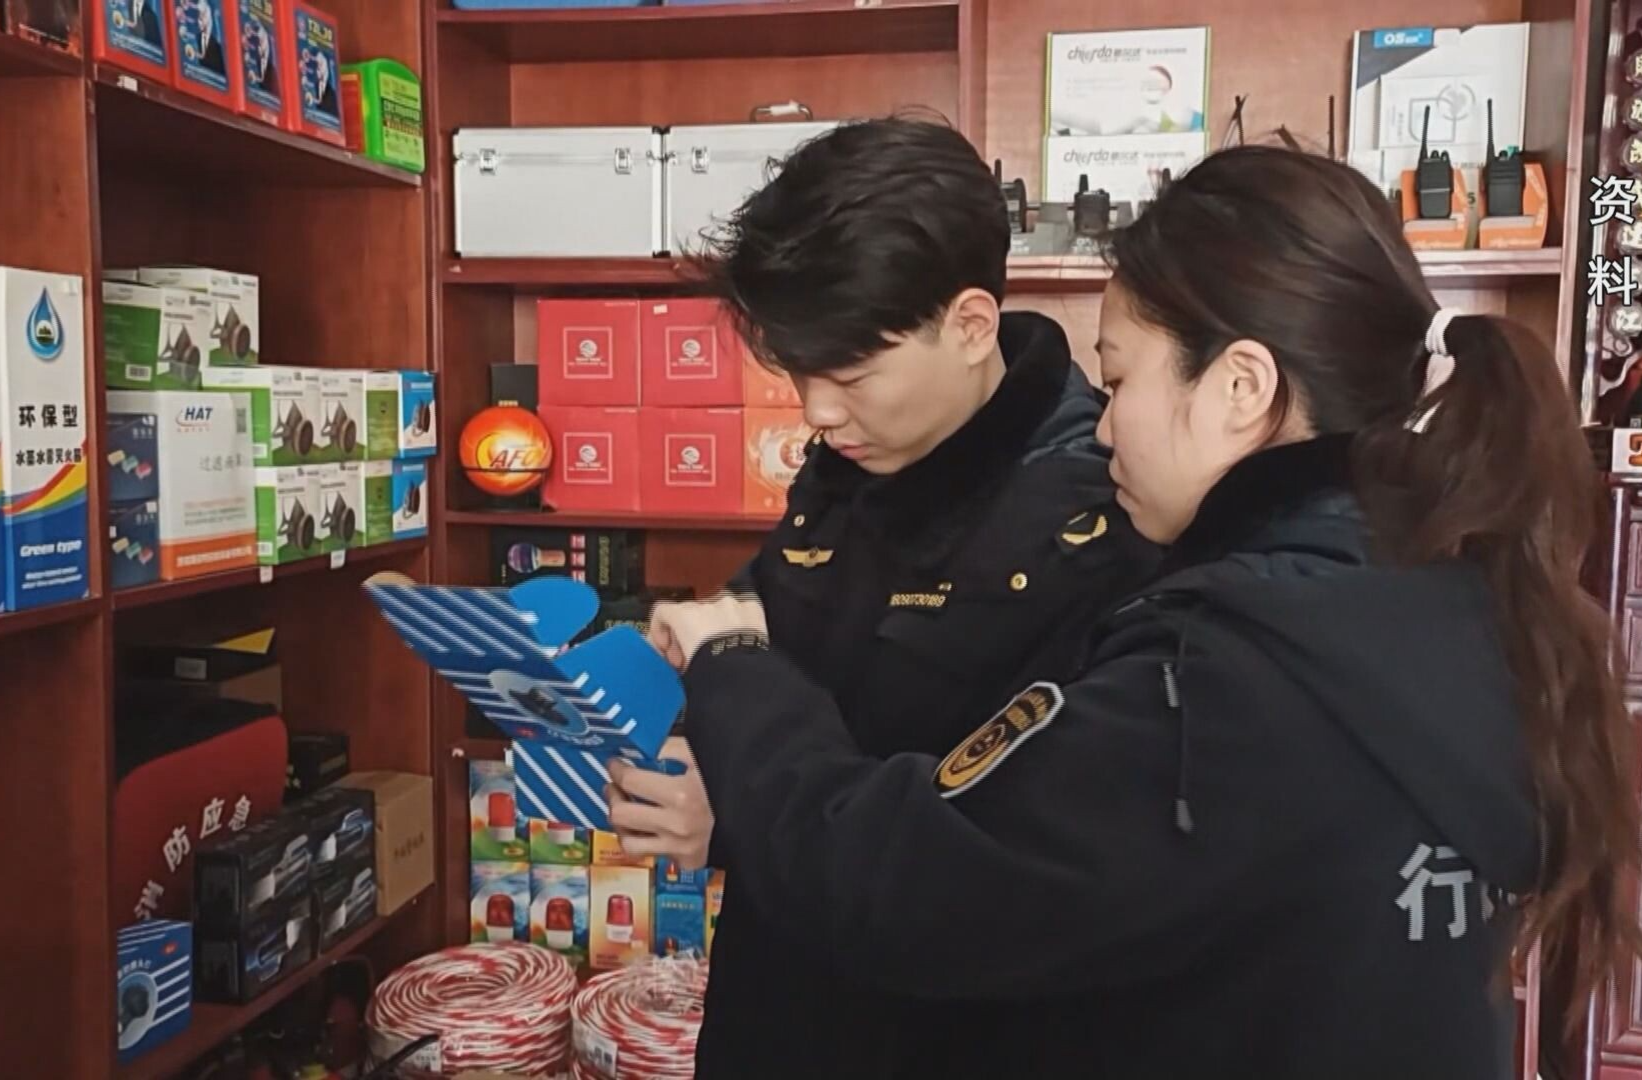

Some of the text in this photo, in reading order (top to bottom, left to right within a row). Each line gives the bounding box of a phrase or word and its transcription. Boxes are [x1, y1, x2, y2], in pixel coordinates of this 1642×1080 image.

[19, 404, 78, 428] 环保型
[184, 406, 214, 421] HAT
[20, 540, 82, 557] Green type
[1395, 842, 1494, 941] 行
